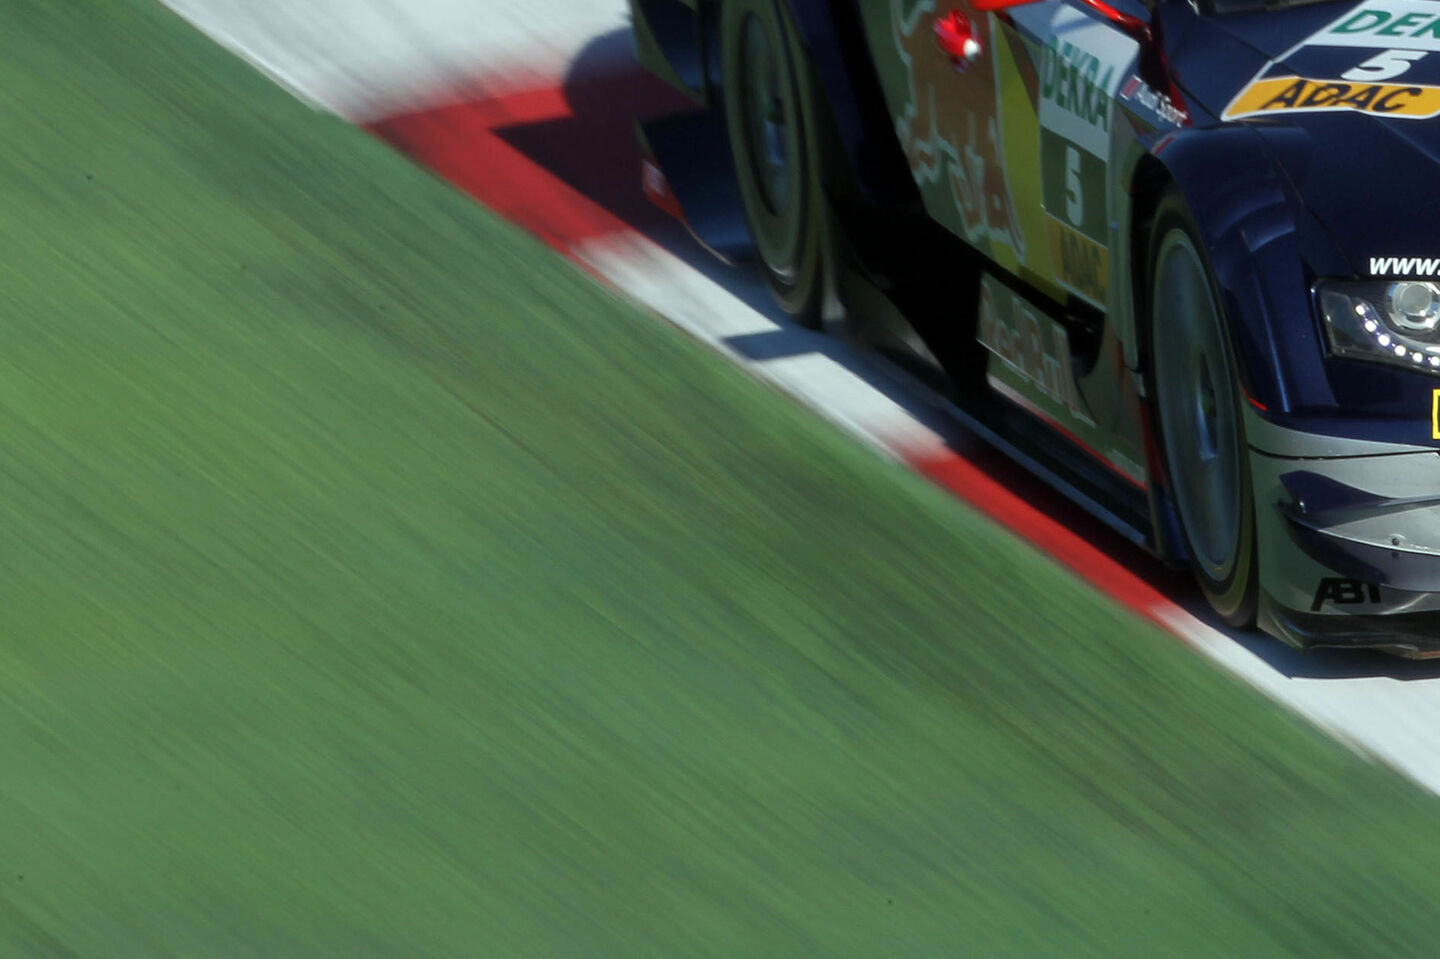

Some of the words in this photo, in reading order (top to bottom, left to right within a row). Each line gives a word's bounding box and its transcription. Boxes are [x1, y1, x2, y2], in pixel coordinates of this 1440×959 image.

[1042, 34, 1115, 133] DEKRA
[1341, 49, 1428, 83] 5
[1270, 78, 1424, 114] ADAC
[1064, 148, 1086, 228] 5
